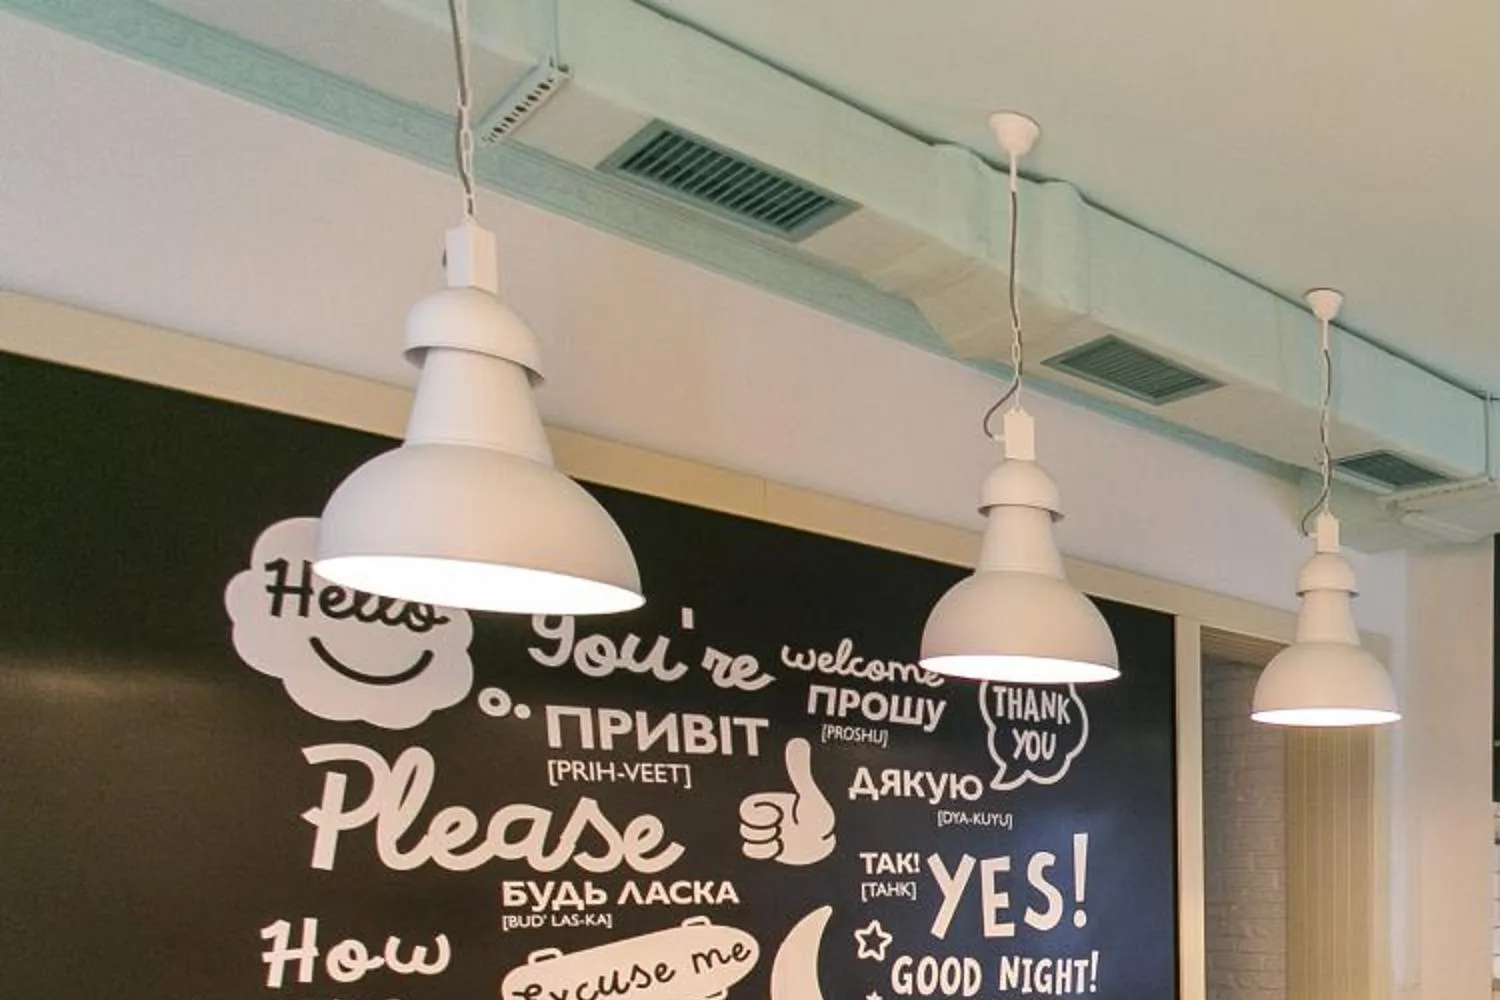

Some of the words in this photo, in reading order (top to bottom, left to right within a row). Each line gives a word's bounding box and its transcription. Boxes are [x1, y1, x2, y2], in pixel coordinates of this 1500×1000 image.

[781, 638, 945, 687] welcome
[807, 684, 947, 733] ПРОШУ
[992, 685, 1071, 725] THANK
[546, 704, 768, 756] ПРИВІТ
[821, 724, 888, 748] [PROSHU]
[1012, 728, 1056, 762] YOU
[548, 759, 691, 788] [PRIH-VEET]
[848, 766, 984, 805] ДЯКУЮ
[301, 743, 685, 872] Please
[860, 852, 920, 875] ТАК!
[502, 880, 608, 912] БУДЬ
[617, 880, 740, 905] ЛАСКА
[861, 881, 917, 902] [TAHK]
[927, 833, 1088, 940] YES!
[260, 918, 451, 989] How
[691, 940, 751, 975] me
[891, 955, 982, 997] GOOD
[999, 951, 1098, 994] NIGHT!
